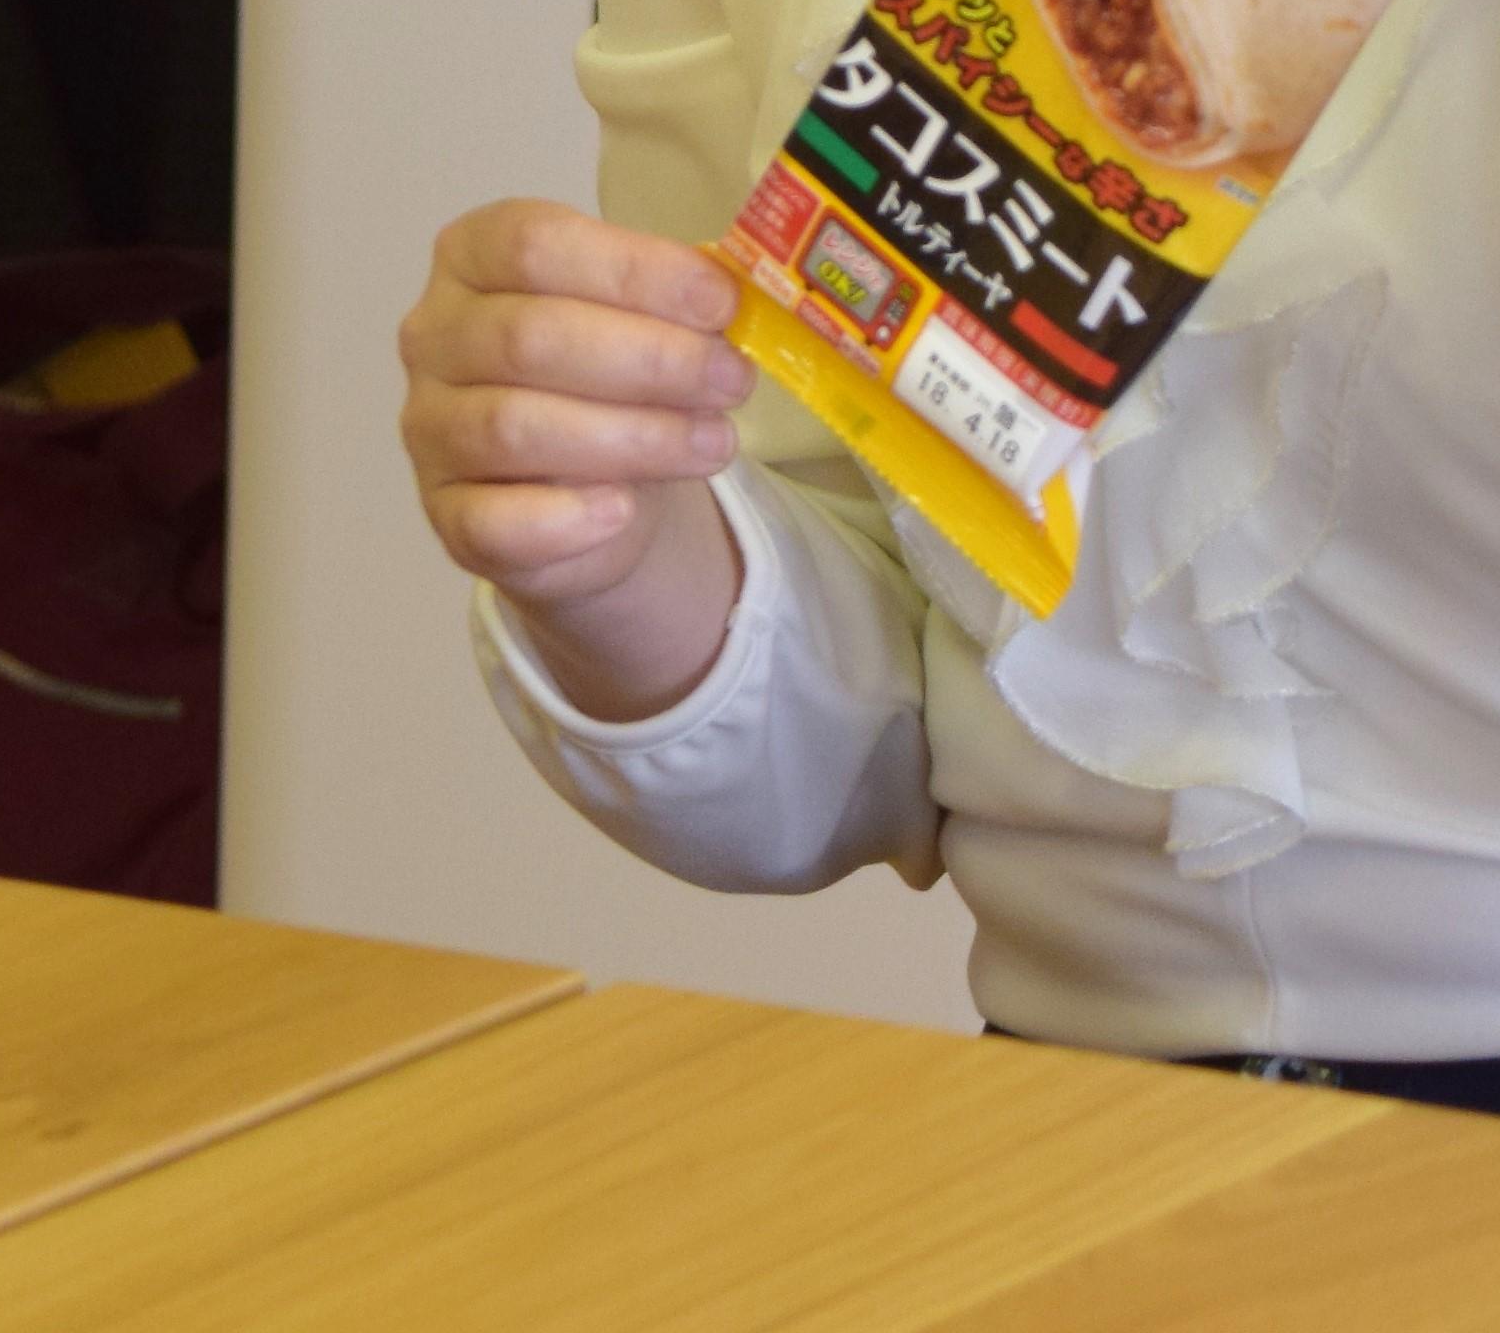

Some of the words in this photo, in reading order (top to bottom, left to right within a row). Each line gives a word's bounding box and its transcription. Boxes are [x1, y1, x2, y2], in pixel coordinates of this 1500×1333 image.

[817, 41, 1150, 331] タコスミート
[875, 178, 1012, 313] トルティーヤ
[818, 259, 868, 305] OK!
